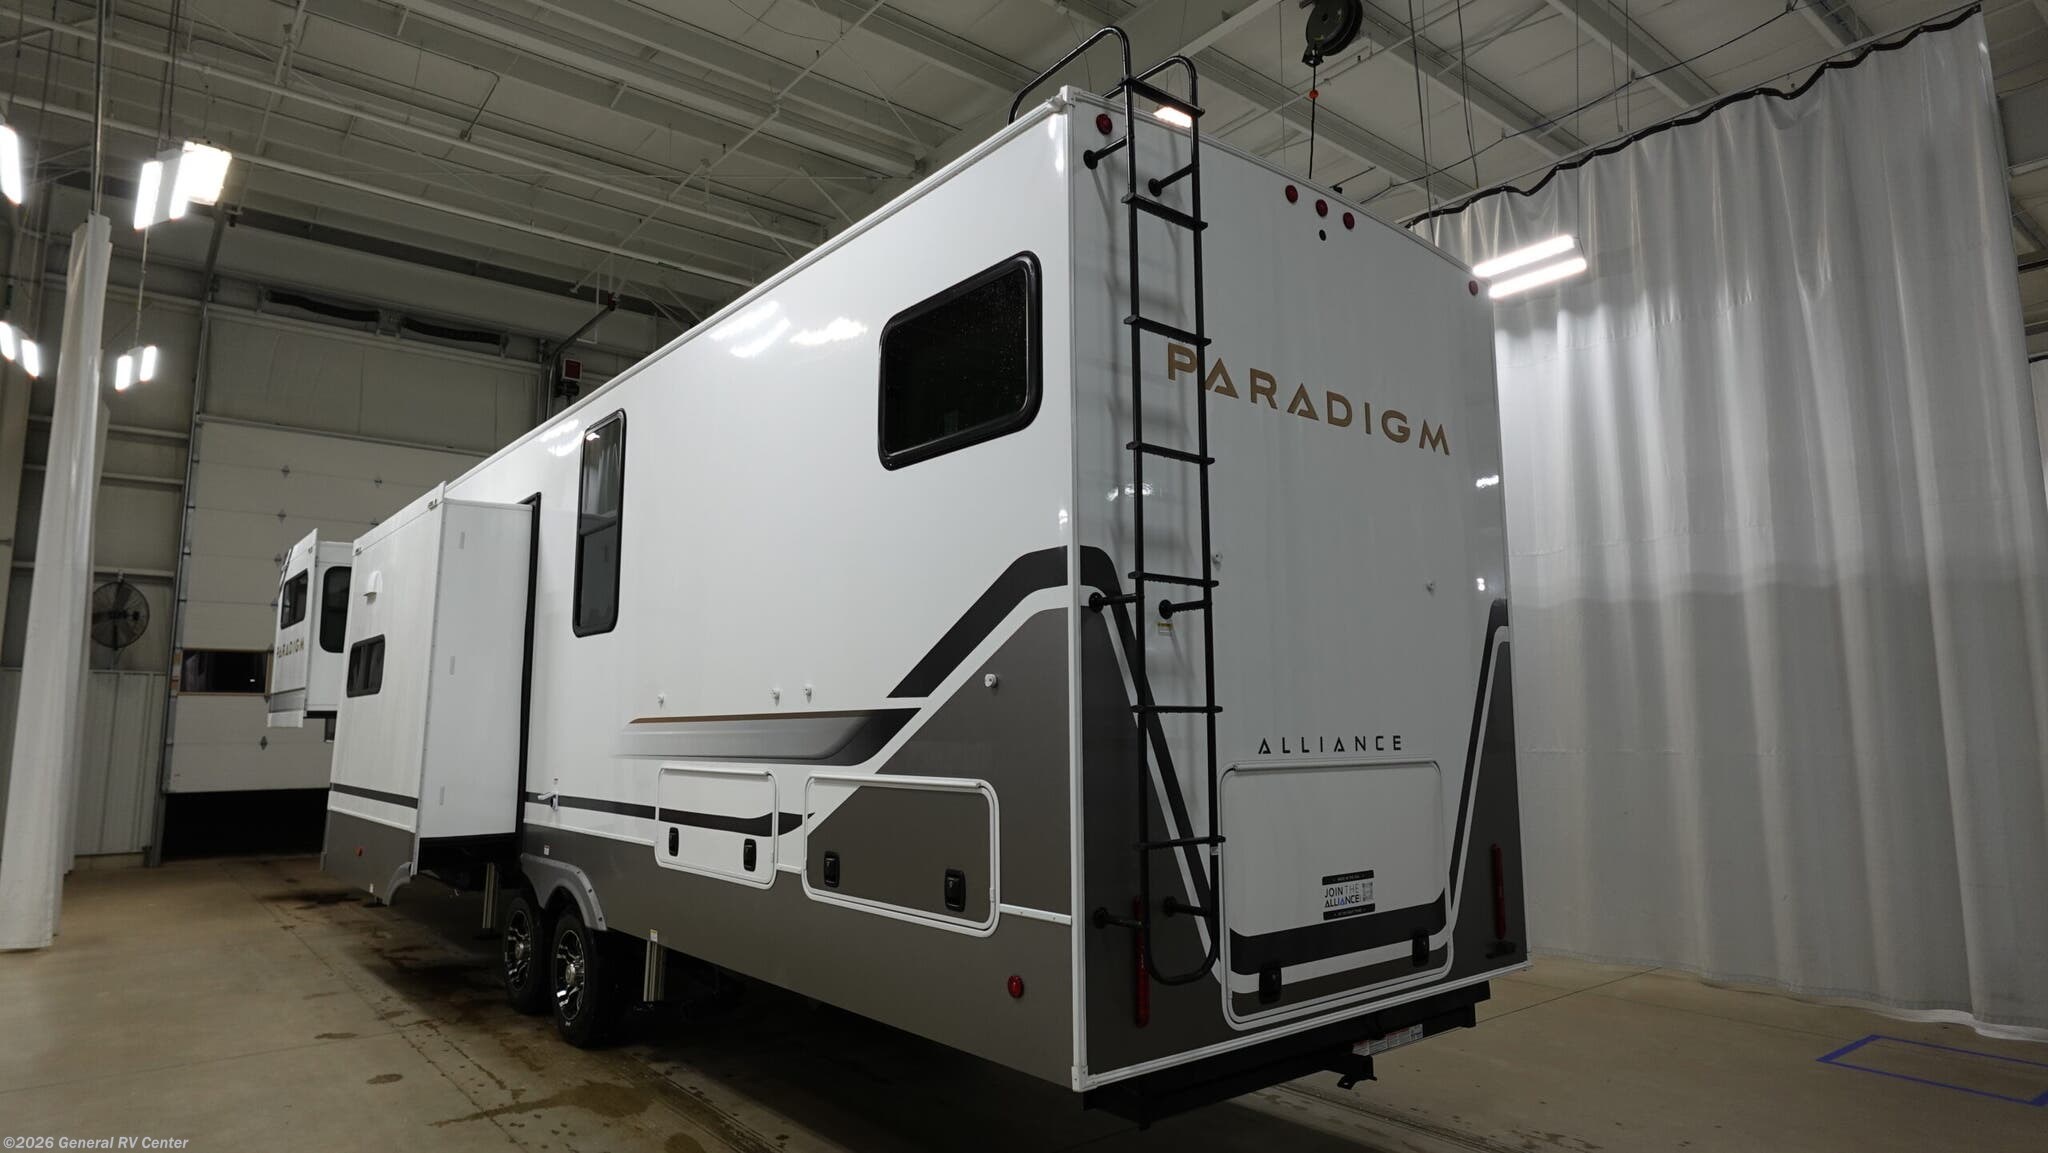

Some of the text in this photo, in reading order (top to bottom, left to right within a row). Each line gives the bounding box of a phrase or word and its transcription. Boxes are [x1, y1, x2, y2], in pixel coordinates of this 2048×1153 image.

[1167, 342, 1450, 456] PARADIGM
[1258, 735, 1402, 755] ALLIANCE
[1325, 883, 1360, 898] JOIN THE
[1325, 894, 1360, 908] ALLIANCE
